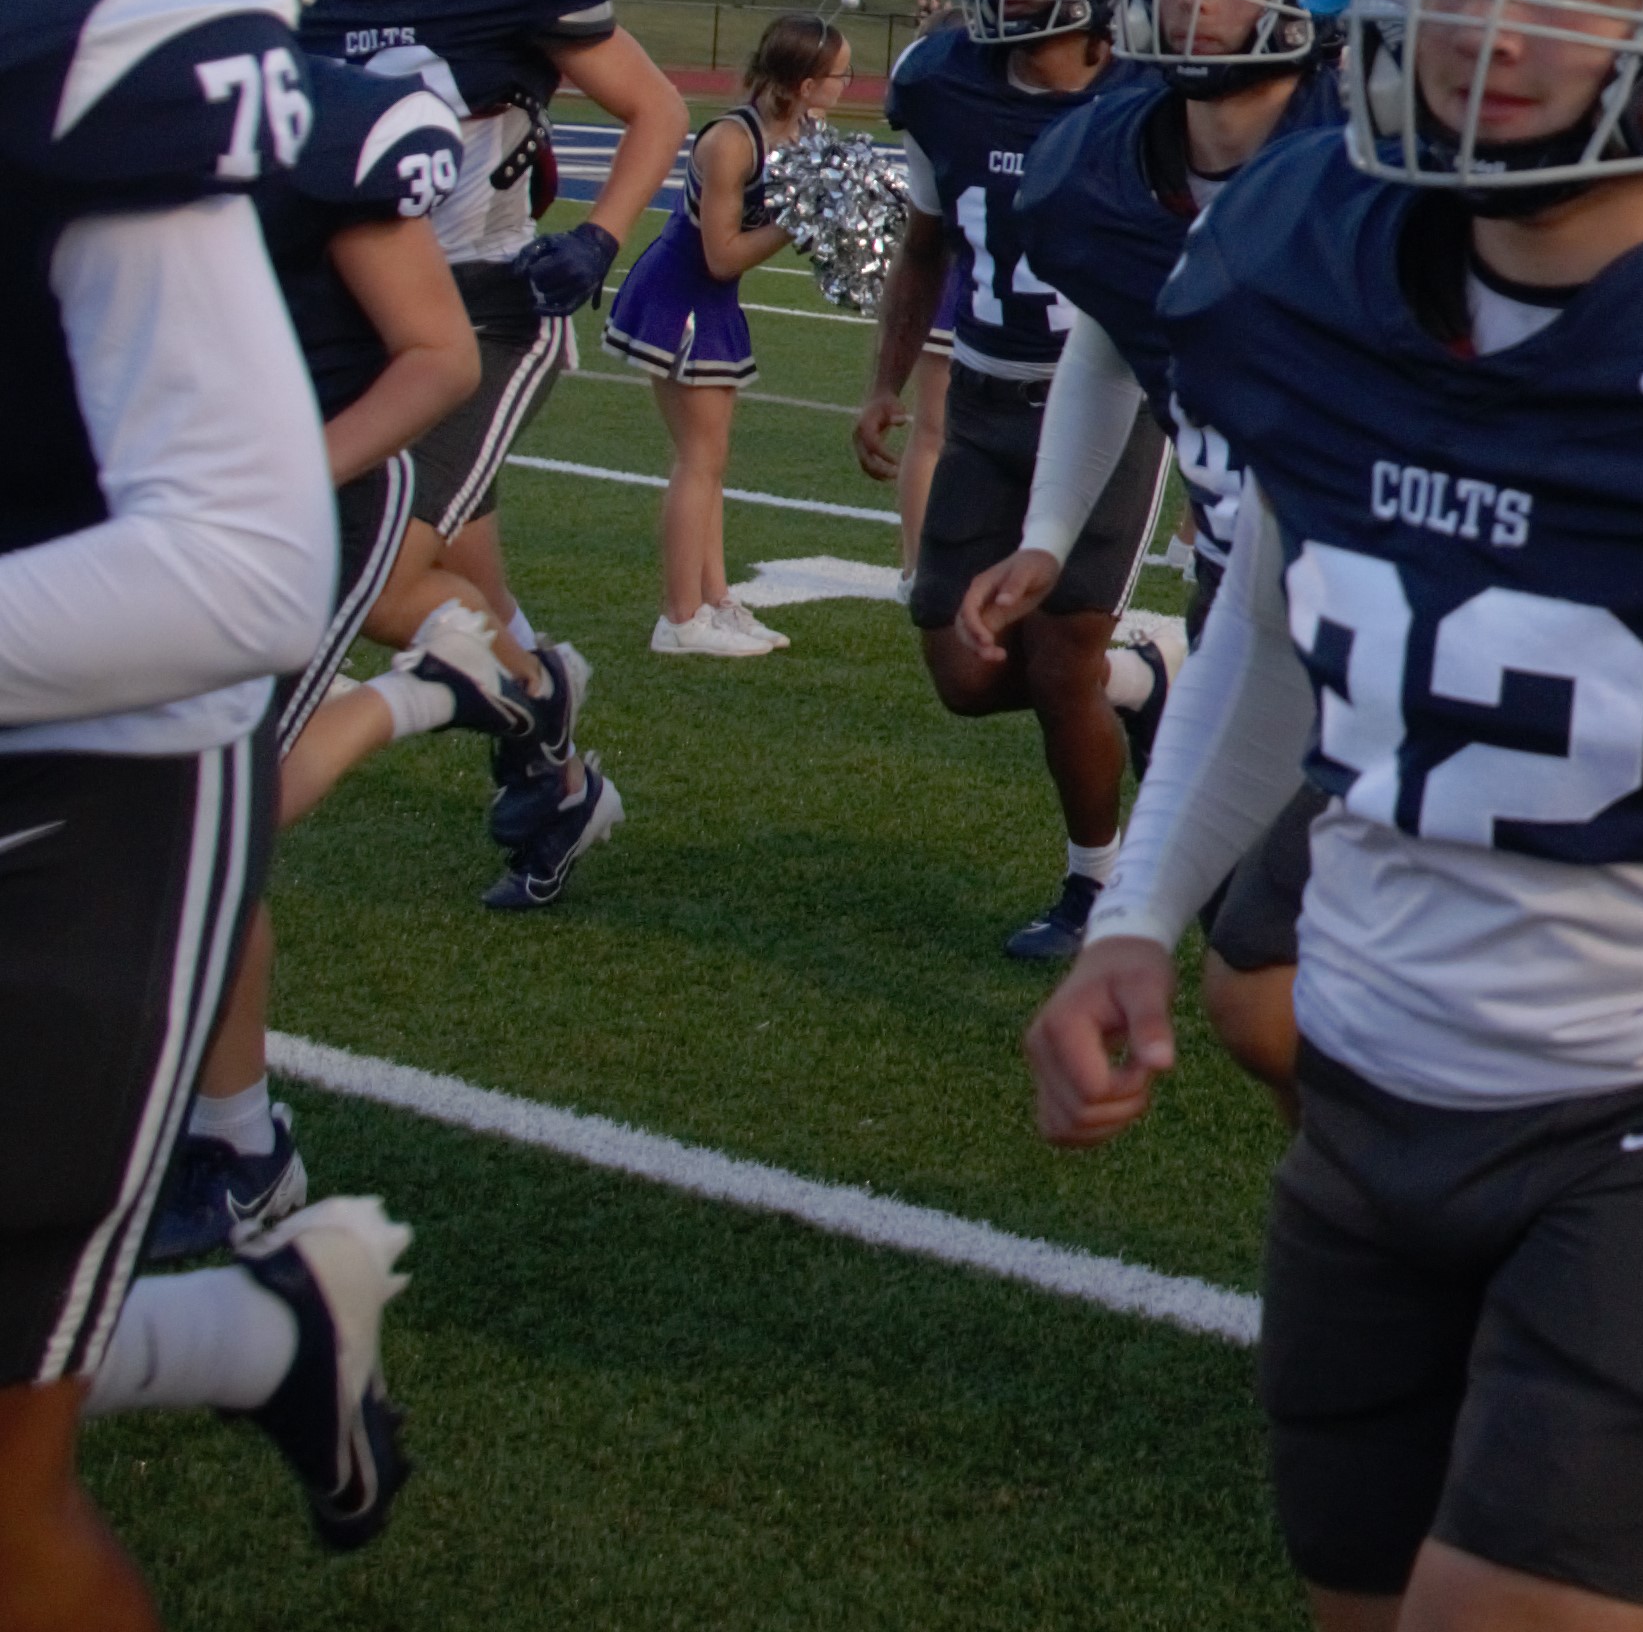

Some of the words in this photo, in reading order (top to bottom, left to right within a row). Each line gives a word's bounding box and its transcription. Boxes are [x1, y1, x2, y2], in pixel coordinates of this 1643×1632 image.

[346, 26, 416, 54] COLTS
[196, 48, 312, 178] 76
[398, 148, 457, 218] 39
[989, 150, 1024, 176] COL
[1371, 460, 1532, 548] COLTS
